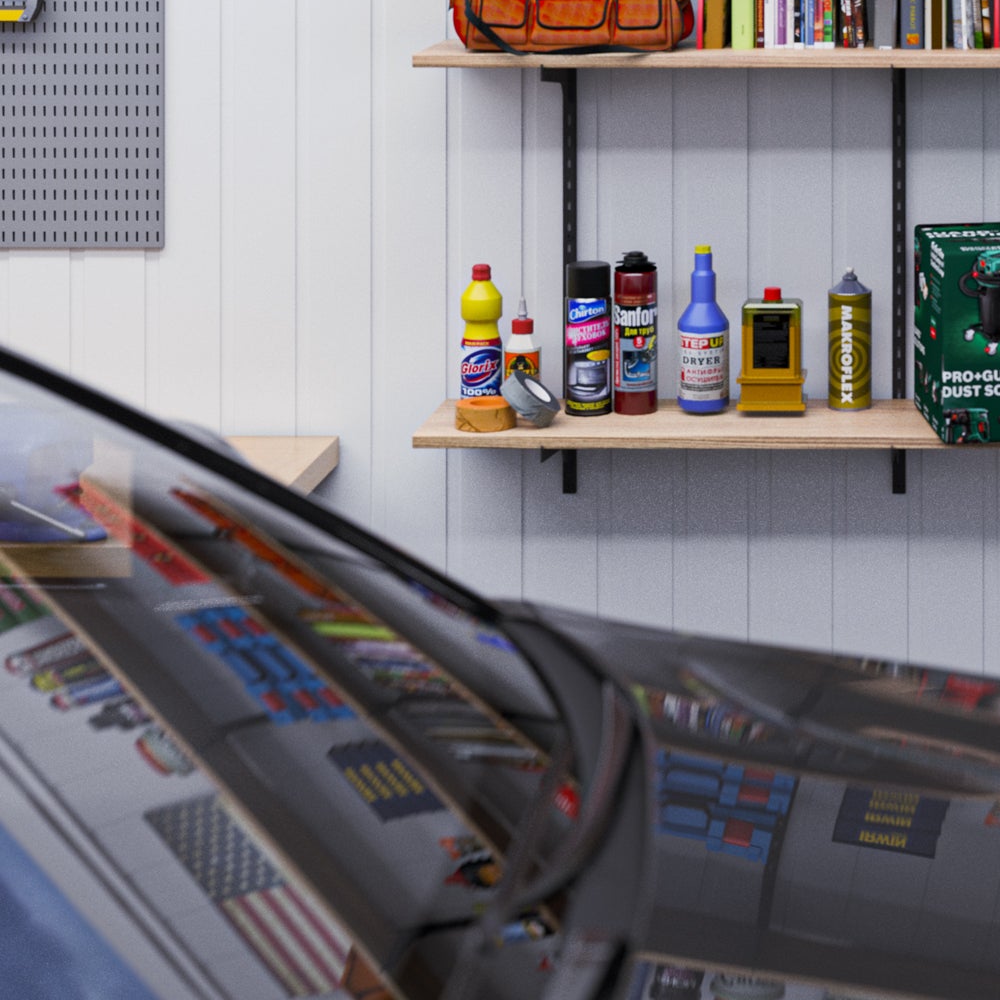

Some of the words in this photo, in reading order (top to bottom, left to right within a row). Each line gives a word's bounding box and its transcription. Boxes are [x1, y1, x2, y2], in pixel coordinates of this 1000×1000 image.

[569, 306, 605, 321] Chirton
[615, 305, 658, 327] Sanfor
[683, 356, 721, 366] DRYER
[841, 305, 854, 404] MAKROFLEX
[461, 359, 498, 375] Glorix
[462, 388, 497, 396] 100%
[942, 384, 983, 399] DUST
